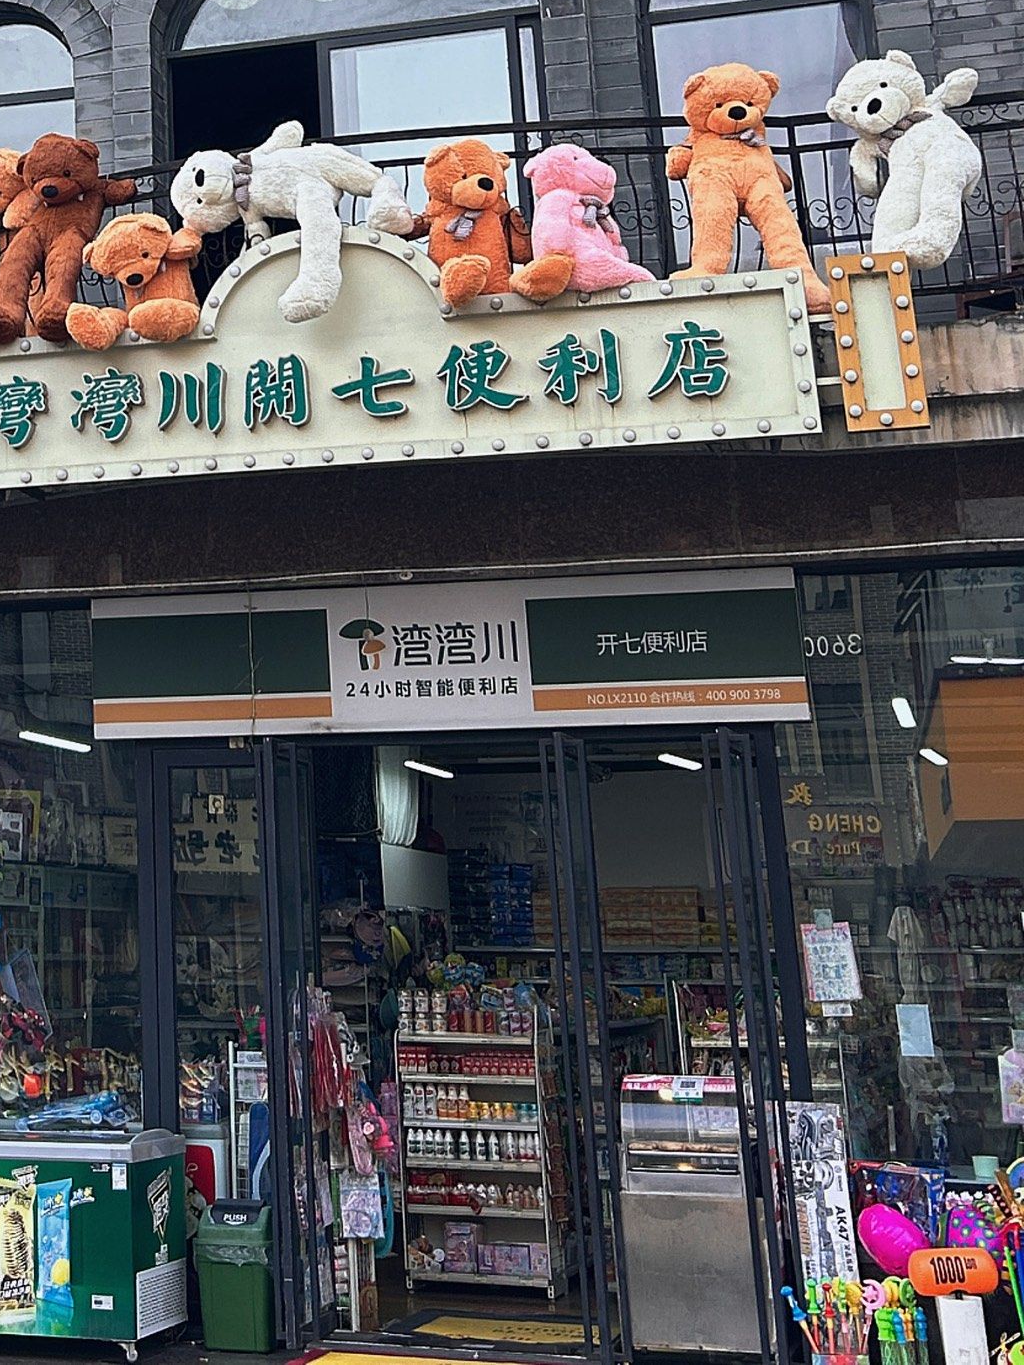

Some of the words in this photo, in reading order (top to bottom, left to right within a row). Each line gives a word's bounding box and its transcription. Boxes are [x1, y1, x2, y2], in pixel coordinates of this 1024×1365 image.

[391, 619, 520, 669] 湾湾川
[596, 628, 709, 656] 开七便利店
[345, 675, 520, 699] 24小时智能便利店
[705, 690, 727, 701] 400
[729, 689, 750, 701] 900
[754, 688, 781, 700] 3798
[223, 1213, 247, 1222] PUSH
[834, 1205, 850, 1241] AK47
[930, 1256, 965, 1285] 1000
